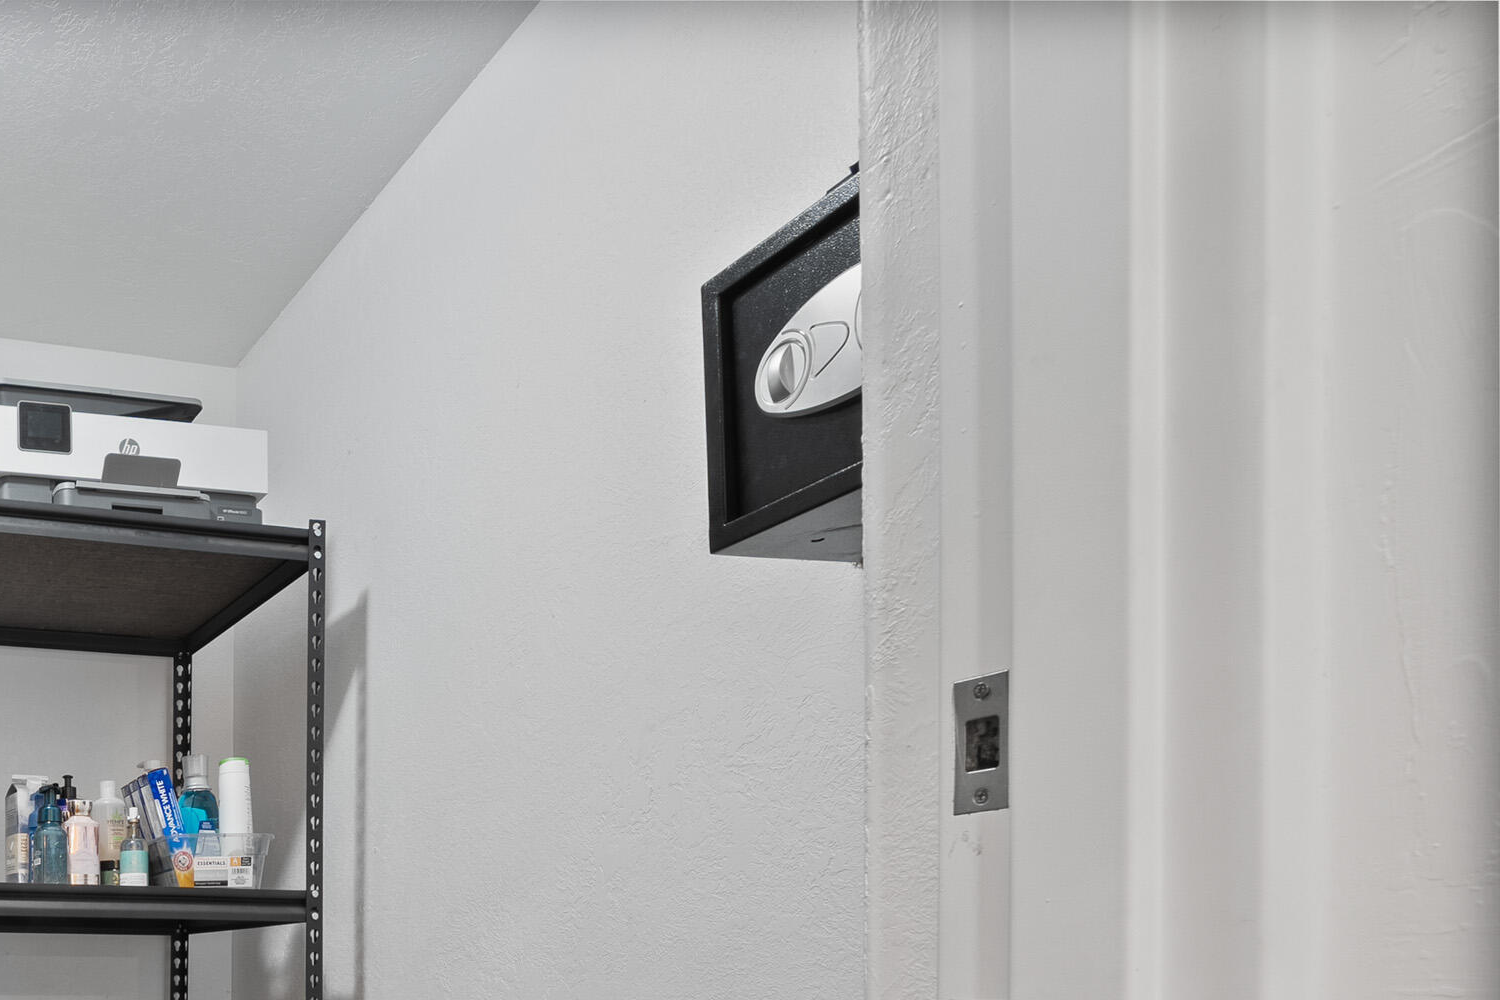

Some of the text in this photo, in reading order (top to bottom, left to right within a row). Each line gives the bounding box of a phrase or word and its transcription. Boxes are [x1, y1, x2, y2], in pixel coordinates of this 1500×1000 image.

[121, 438, 138, 456] hp
[156, 779, 180, 843] ADVANCE WHITE
